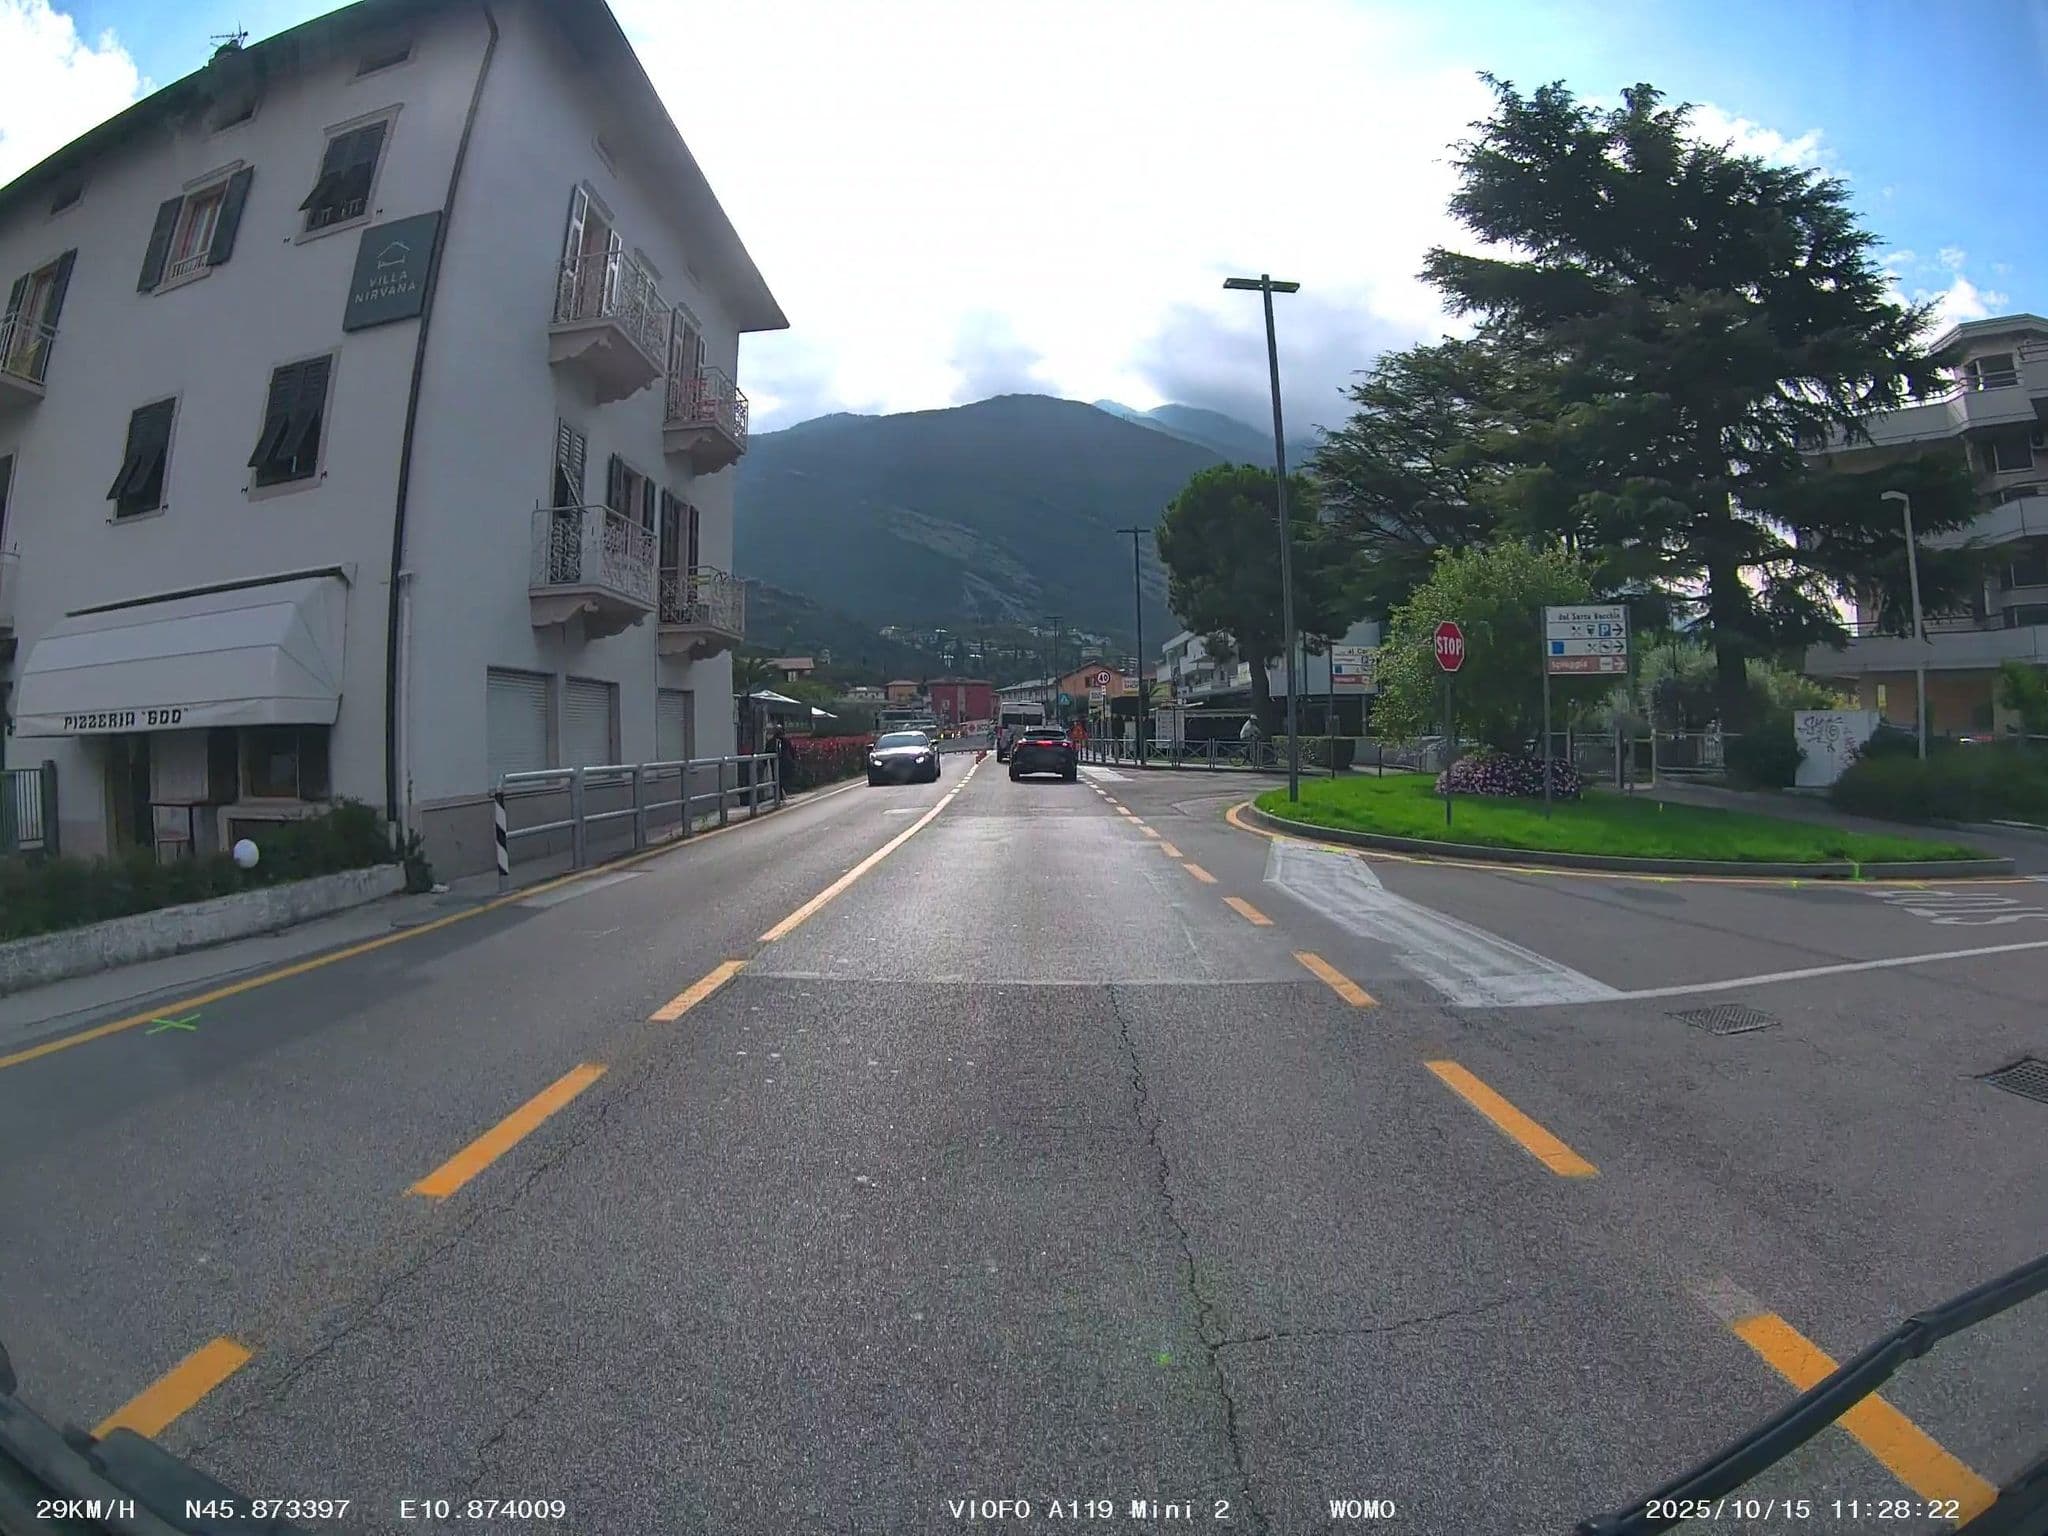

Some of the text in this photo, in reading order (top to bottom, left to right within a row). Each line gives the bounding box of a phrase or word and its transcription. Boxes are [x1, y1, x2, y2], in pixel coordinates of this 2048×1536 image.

[369, 270, 408, 288] VILLA
[354, 281, 416, 304] NIRVANA
[1437, 636, 1462, 656] STOP
[64, 711, 135, 729] PIZZERIA
